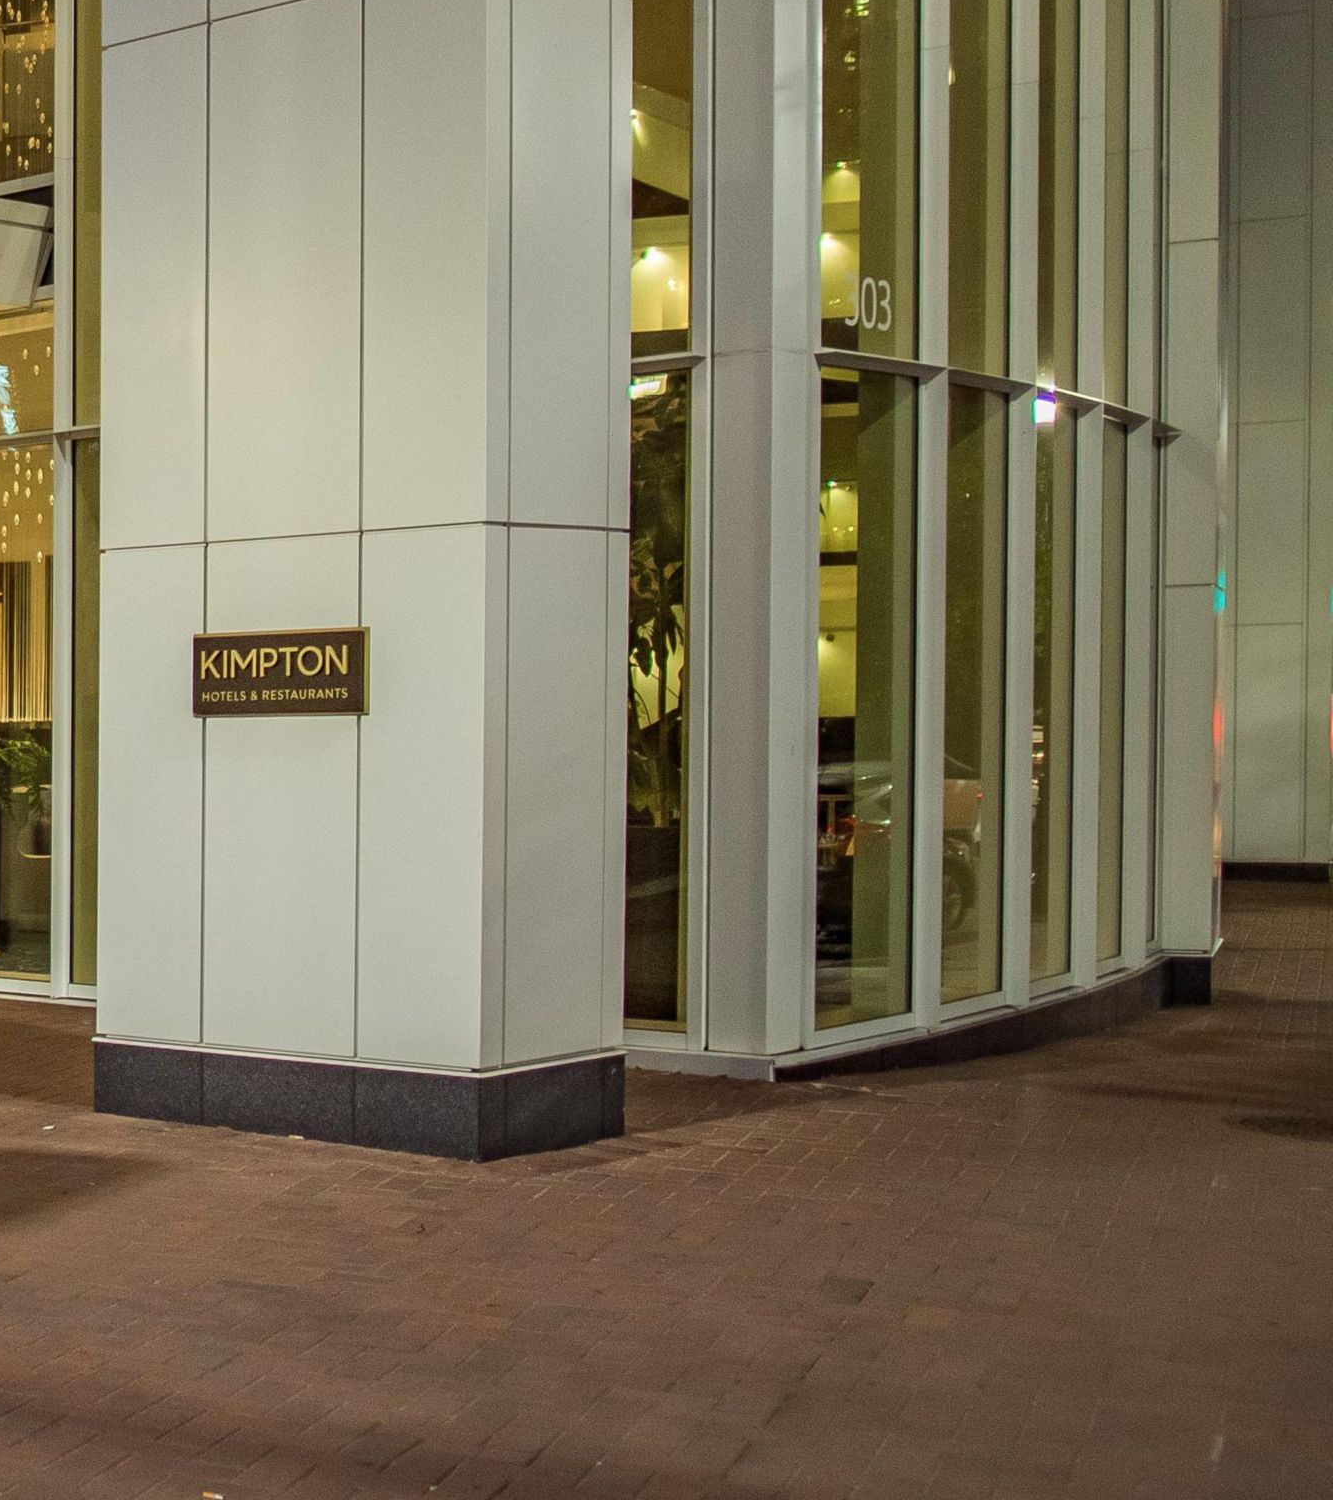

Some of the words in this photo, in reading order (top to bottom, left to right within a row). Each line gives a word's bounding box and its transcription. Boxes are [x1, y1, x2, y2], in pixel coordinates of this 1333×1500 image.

[200, 645, 349, 680] KIMPTON
[202, 691, 247, 702] HOTELS
[251, 691, 258, 701] &
[262, 688, 348, 701] RESTAURANTS
